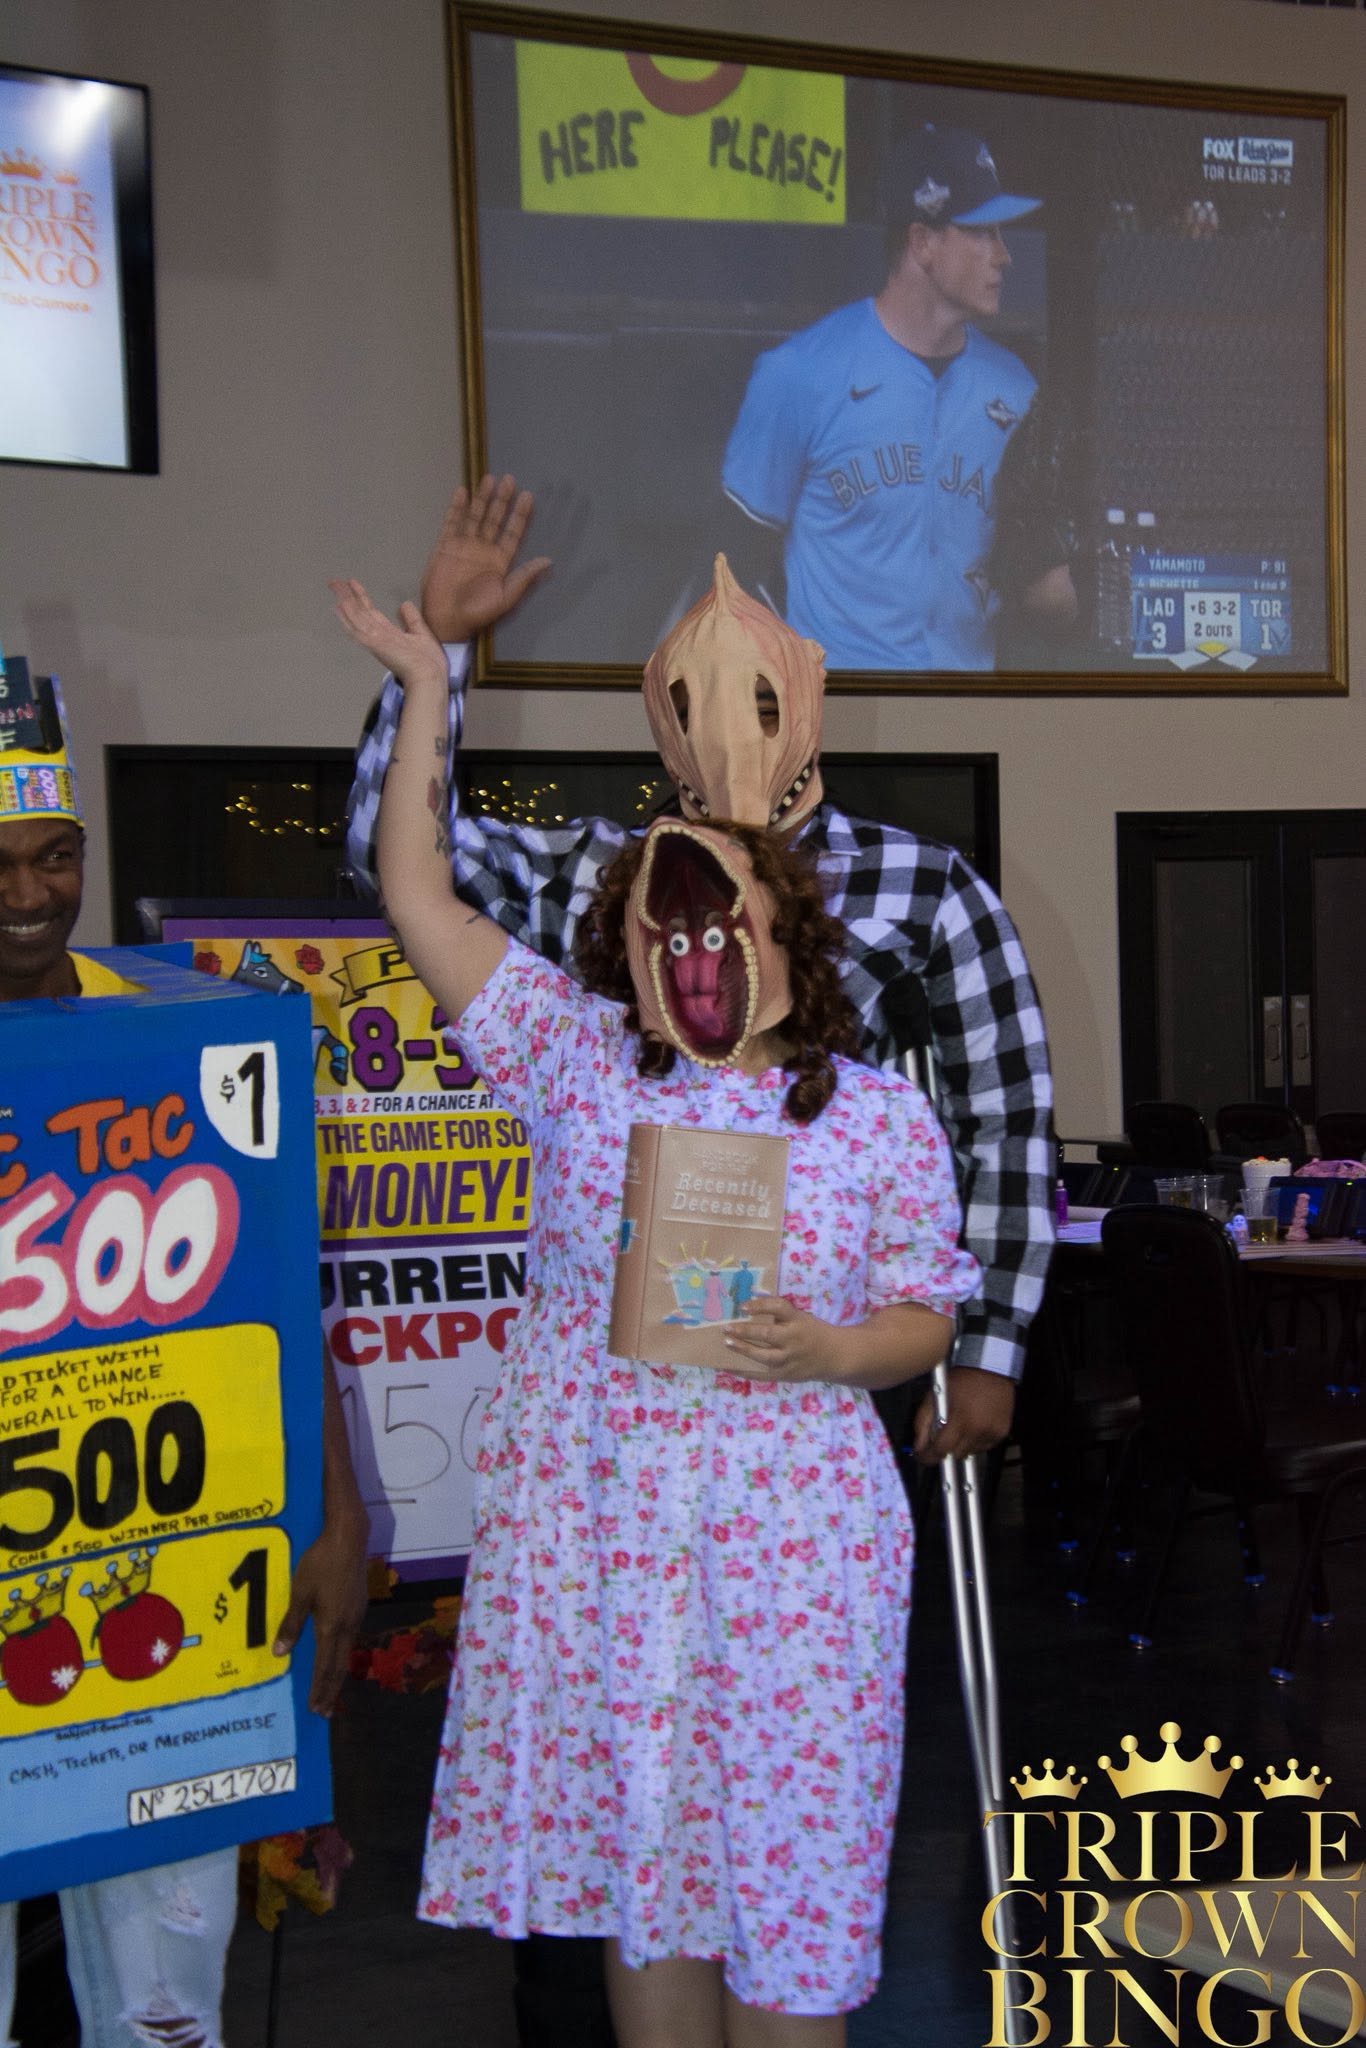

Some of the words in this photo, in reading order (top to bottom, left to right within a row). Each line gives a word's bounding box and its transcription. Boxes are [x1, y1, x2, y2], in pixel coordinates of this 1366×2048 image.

[538, 108, 646, 185] HERE
[709, 115, 842, 204] PLEASE!
[1203, 137, 1235, 161] FOX
[1203, 164, 1225, 180] TOR
[1228, 165, 1266, 184] LEADS
[1270, 167, 1292, 186] 3-2
[0, 215, 96, 253] OWN
[827, 443, 927, 513] BLUE
[1149, 558, 1206, 574] YAMAMOTO
[1213, 600, 1237, 616] 3-2
[1250, 599, 1283, 618] TOR
[1151, 621, 1168, 650] 3
[1194, 622, 1203, 637] 2
[1205, 624, 1233, 638] OUTS
[1260, 623, 1273, 650] 1
[346, 1097, 358, 1114] &
[360, 1097, 371, 1113] 2
[374, 1096, 402, 1113] FOR
[404, 1096, 416, 1112] A
[418, 1094, 476, 1112] CHANCE
[318, 1123, 367, 1155] THE
[370, 1120, 442, 1153] GAME
[445, 1118, 493, 1150] FOR
[324, 1157, 531, 1231] MONEY!
[676, 1172, 770, 1200] Recently
[671, 1191, 771, 1219] Deceased
[20, 1358, 90, 1387] TICKET
[96, 1344, 161, 1367] WITH
[0, 1387, 38, 1409] FOR
[51, 1384, 65, 1399] A
[77, 1363, 164, 1394] CHANCE
[83, 1398, 107, 1414] TO
[109, 1518, 180, 1544] WINNER
[184, 1513, 209, 1529] PER
[9, 1762, 59, 1785] CASH,
[128, 1741, 148, 1756] OR
